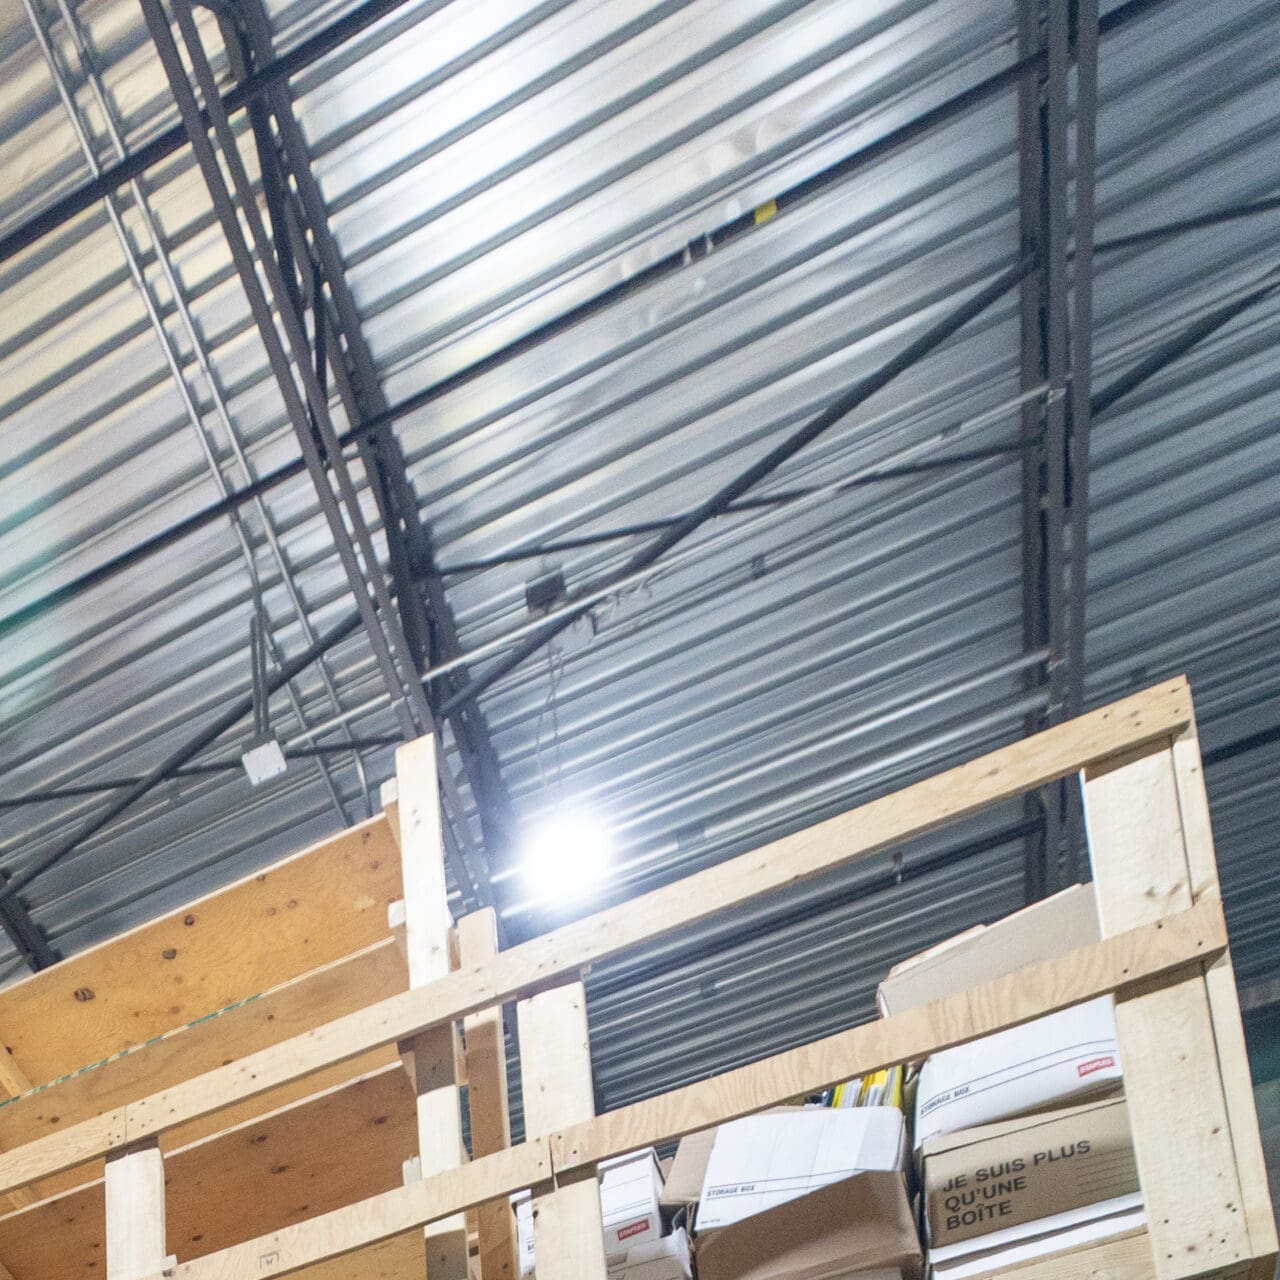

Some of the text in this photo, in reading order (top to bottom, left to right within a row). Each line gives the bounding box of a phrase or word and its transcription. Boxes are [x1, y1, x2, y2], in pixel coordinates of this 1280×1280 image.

[943, 1140, 1091, 1193] JE SUIS PLUS
[706, 1184, 757, 1198] STORAGE BOX
[944, 1176, 1028, 1213] QU'UNE
[618, 1220, 650, 1240] STAPLES
[946, 1200, 1013, 1231] BOÎTE
